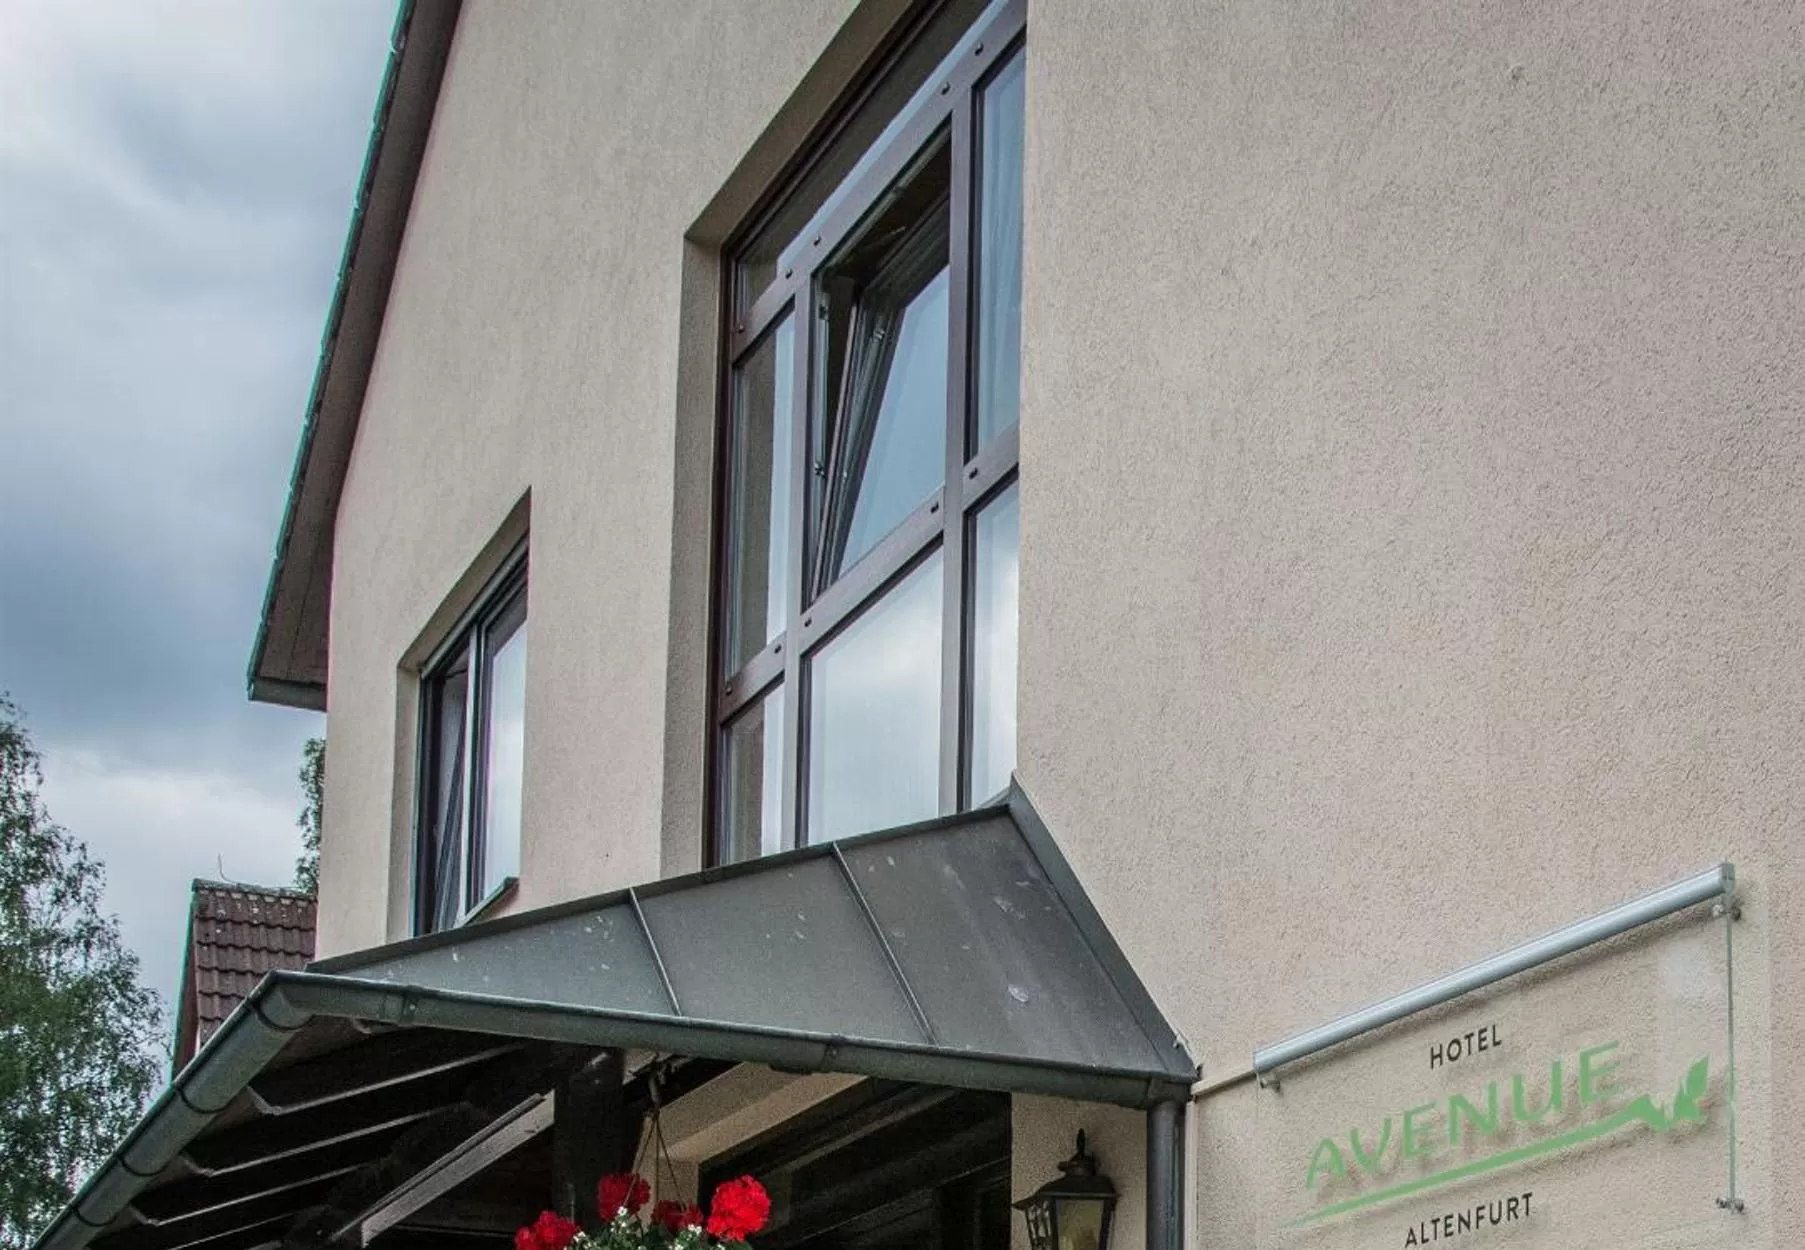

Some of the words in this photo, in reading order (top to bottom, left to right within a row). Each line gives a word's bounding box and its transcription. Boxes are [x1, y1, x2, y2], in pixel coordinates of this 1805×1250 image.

[1429, 1023, 1503, 1070] HOTEL
[1306, 1040, 1620, 1190] AVENUE
[1403, 1192, 1534, 1249] ALTENFURT
